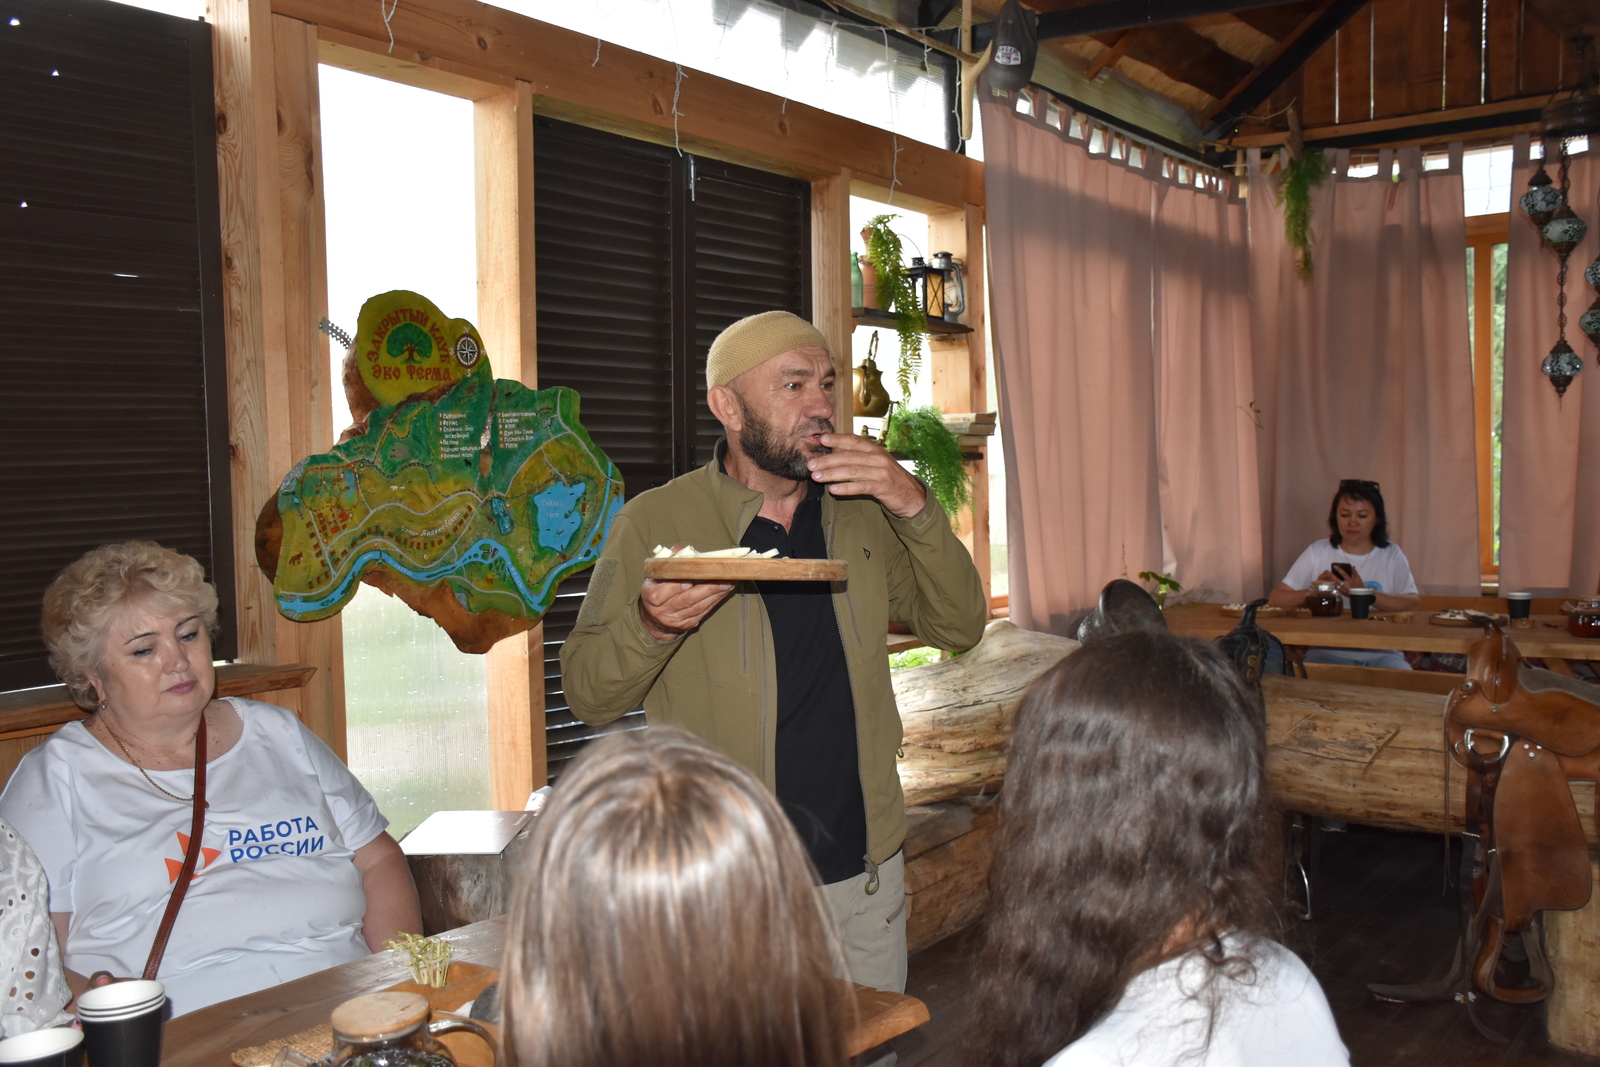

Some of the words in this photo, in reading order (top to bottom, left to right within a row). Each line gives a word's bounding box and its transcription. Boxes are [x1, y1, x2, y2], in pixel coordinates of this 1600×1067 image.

[366, 308, 430, 362] ЗАКРЫТЫЙ
[429, 322, 451, 364] КЛУБ
[371, 364, 401, 380] ЭКО
[406, 364, 452, 381] ФЕРМА
[229, 816, 319, 846] РАБОТА
[229, 835, 324, 863] РОССИИ
